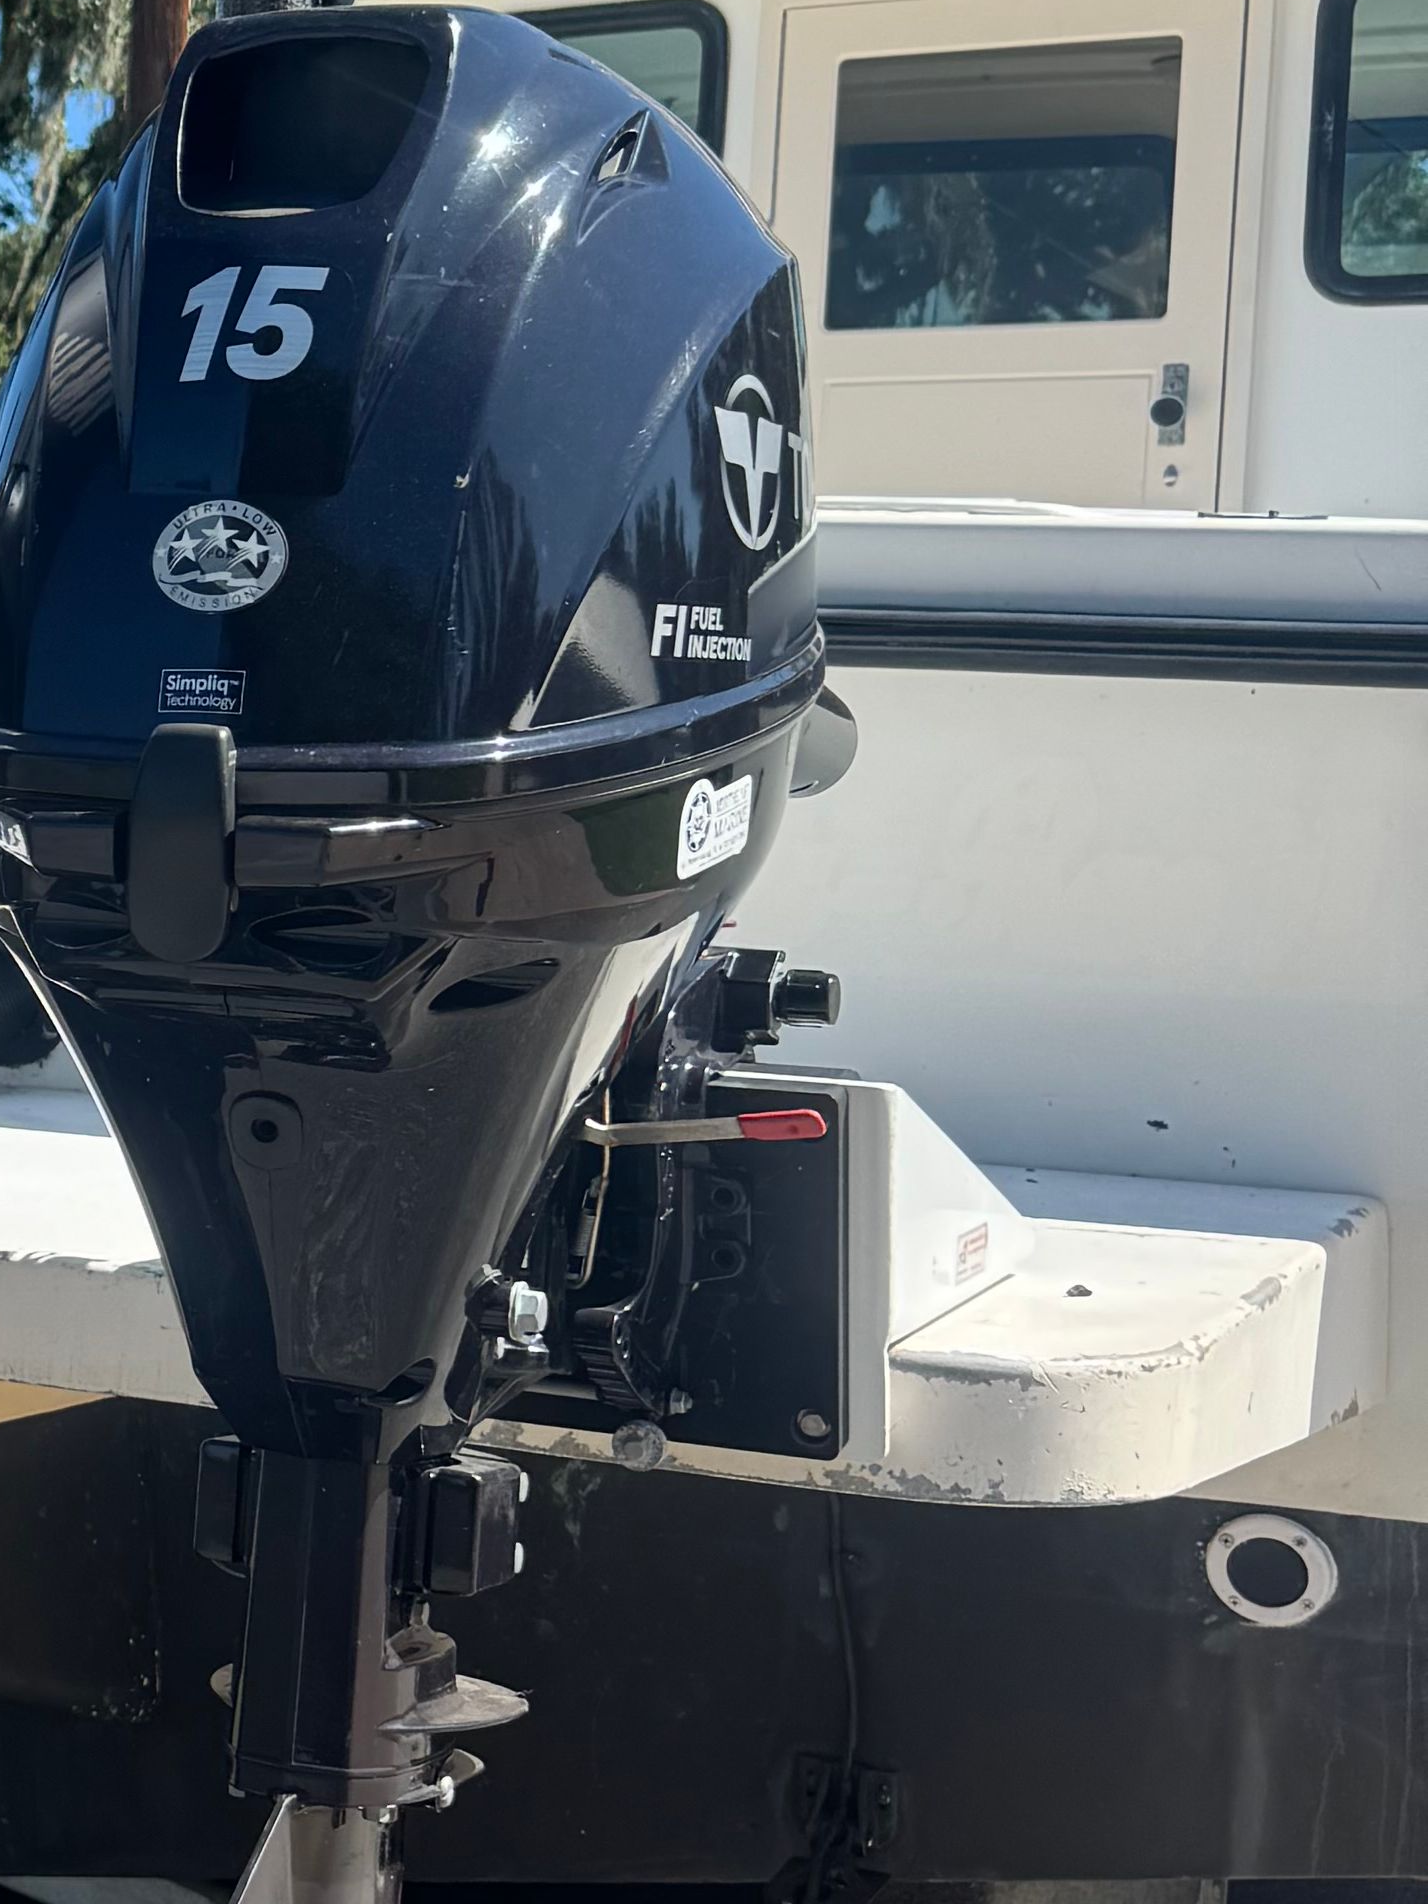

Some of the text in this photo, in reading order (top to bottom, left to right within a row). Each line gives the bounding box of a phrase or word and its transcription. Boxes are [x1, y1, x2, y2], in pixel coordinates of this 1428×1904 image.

[178, 265, 330, 382] 15
[171, 502, 276, 536] ULTRA LOW
[169, 585, 257, 609] EMISSION
[650, 604, 724, 657] FI FUEL
[687, 634, 752, 661] INJECTION
[165, 693, 237, 711] Technology
